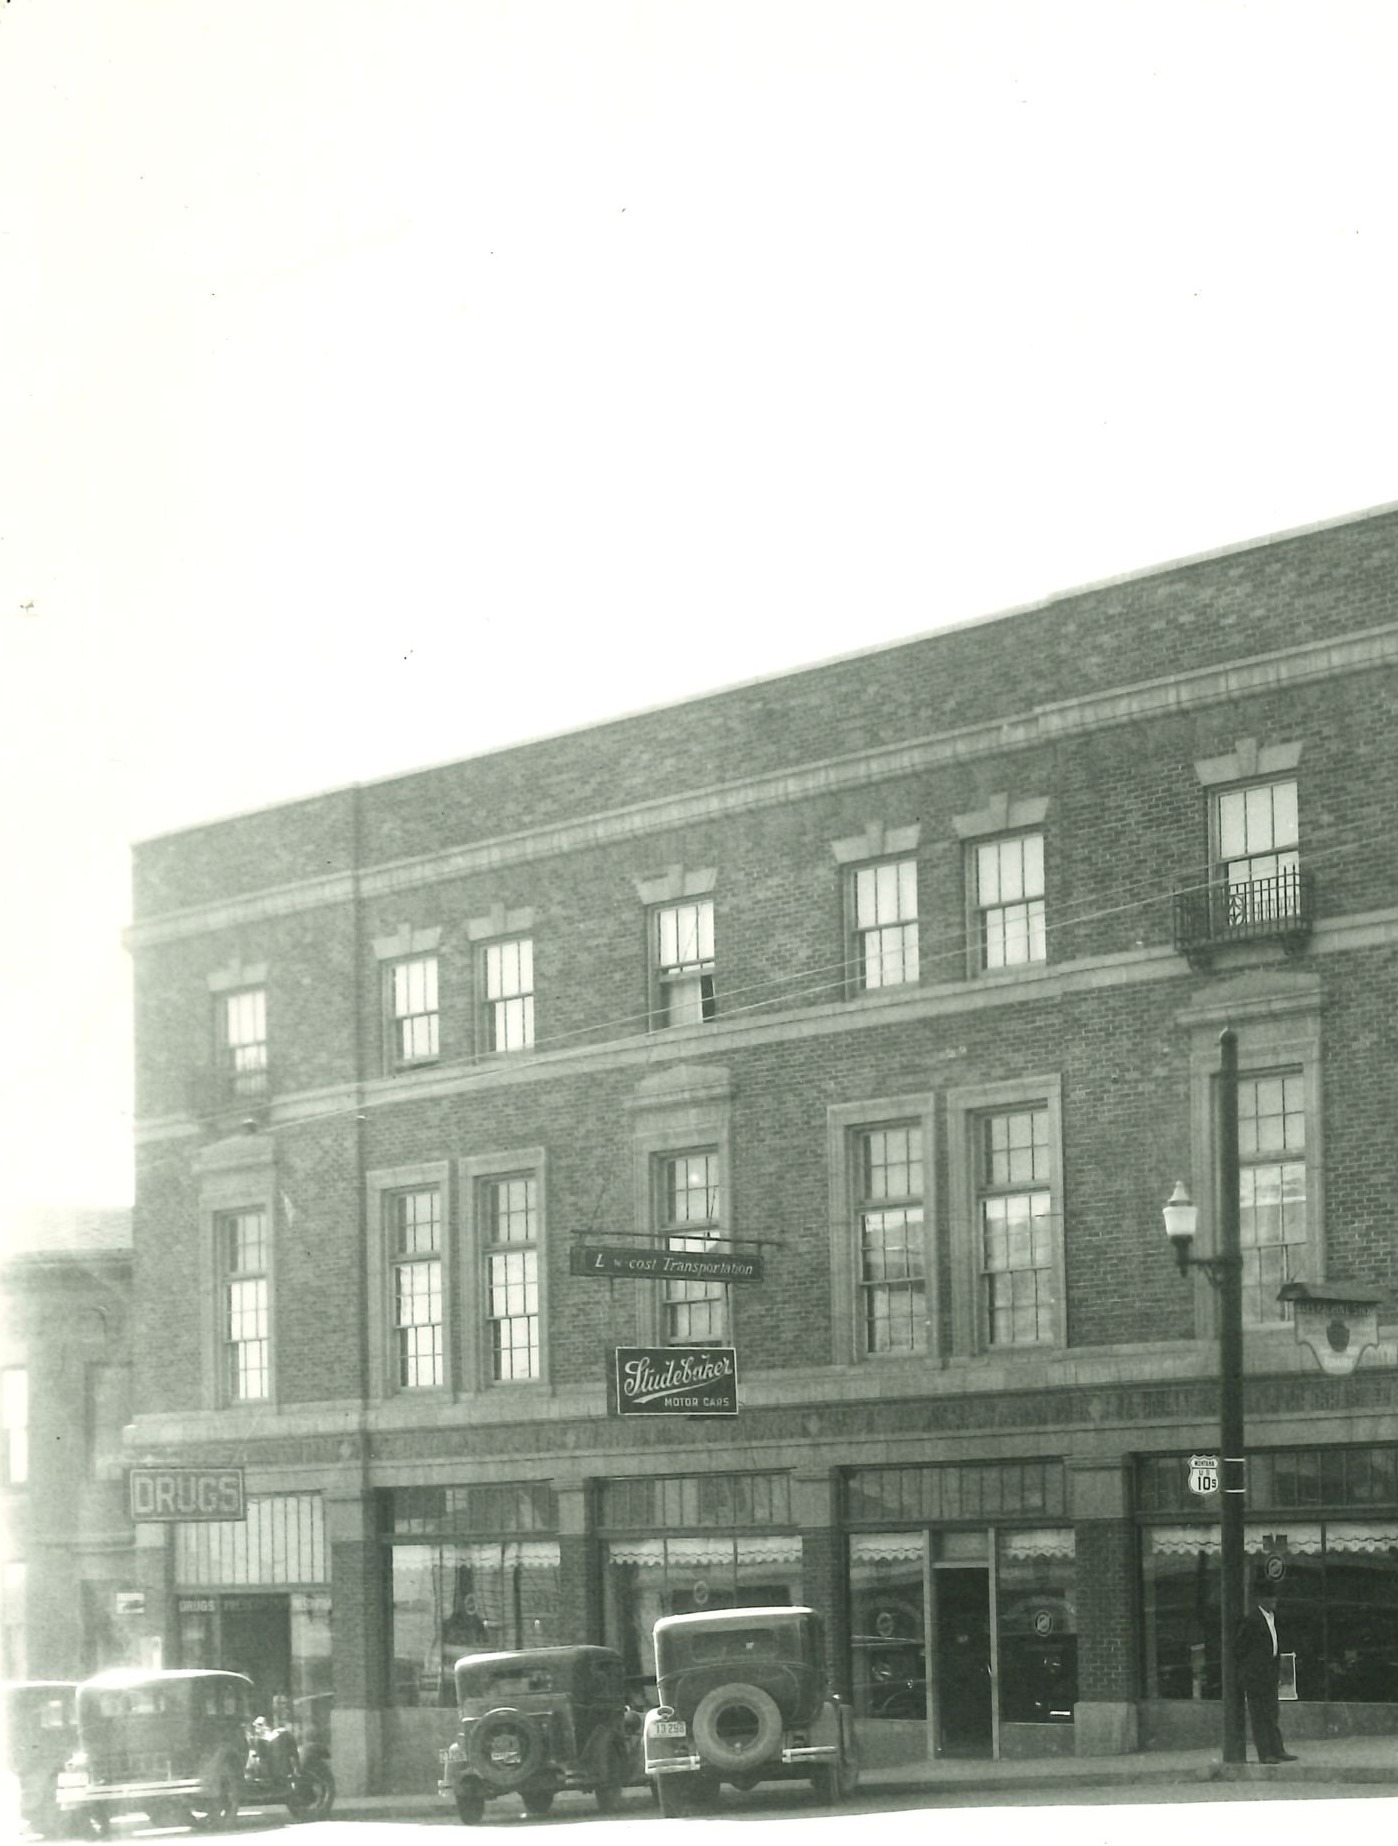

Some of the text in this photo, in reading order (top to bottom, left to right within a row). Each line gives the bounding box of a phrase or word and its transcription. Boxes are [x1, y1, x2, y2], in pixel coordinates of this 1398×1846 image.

[662, 1257, 753, 1277] Transportation
[624, 1353, 733, 1397] Studebaker
[664, 1397, 729, 1407] MOTOR CARS
[134, 1476, 239, 1513] DRUGS
[179, 1600, 216, 1613] DRUGS
